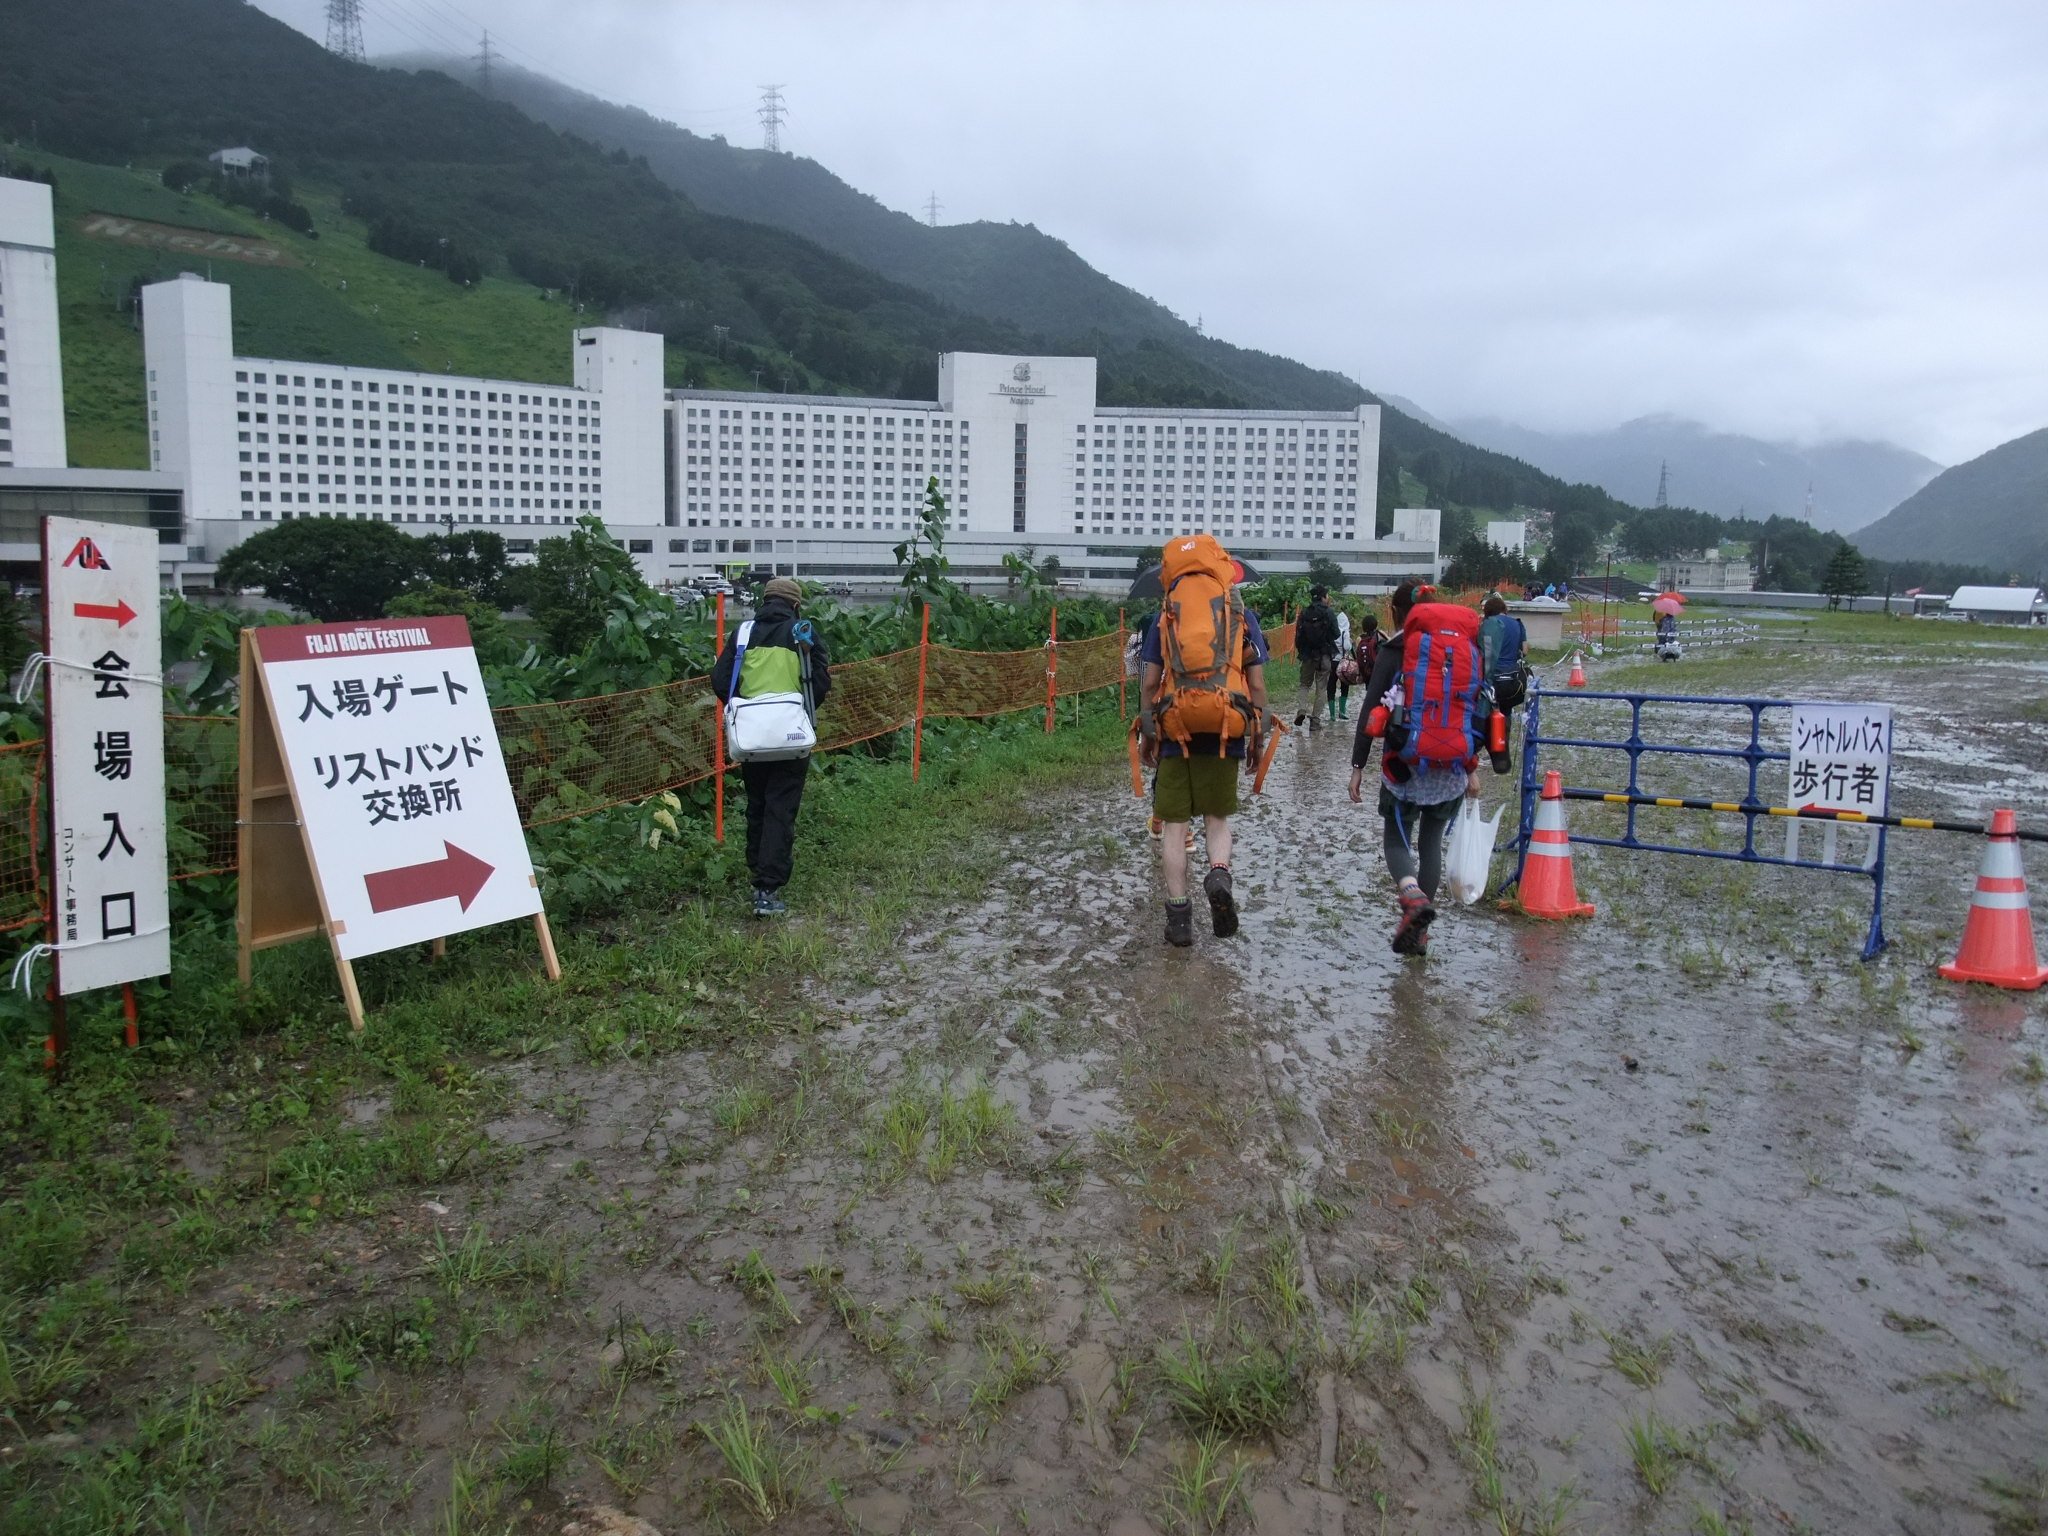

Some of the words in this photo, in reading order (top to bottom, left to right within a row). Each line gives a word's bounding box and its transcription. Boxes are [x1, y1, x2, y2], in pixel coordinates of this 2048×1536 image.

[999, 383, 1023, 393] Prince
[1025, 384, 1046, 394] Hotel
[306, 633, 339, 654] FUJI
[338, 630, 376, 652] ROCK
[375, 627, 432, 649] FESTIVAL
[296, 670, 469, 724] 入場ゲート
[1797, 715, 1884, 754] シャトルバス
[313, 735, 484, 790] リストバンド
[1793, 759, 1880, 804] 歩行者
[92, 649, 137, 940] 会場入口
[362, 778, 463, 827] 交換所
[64, 827, 78, 941] コンサート事務局
